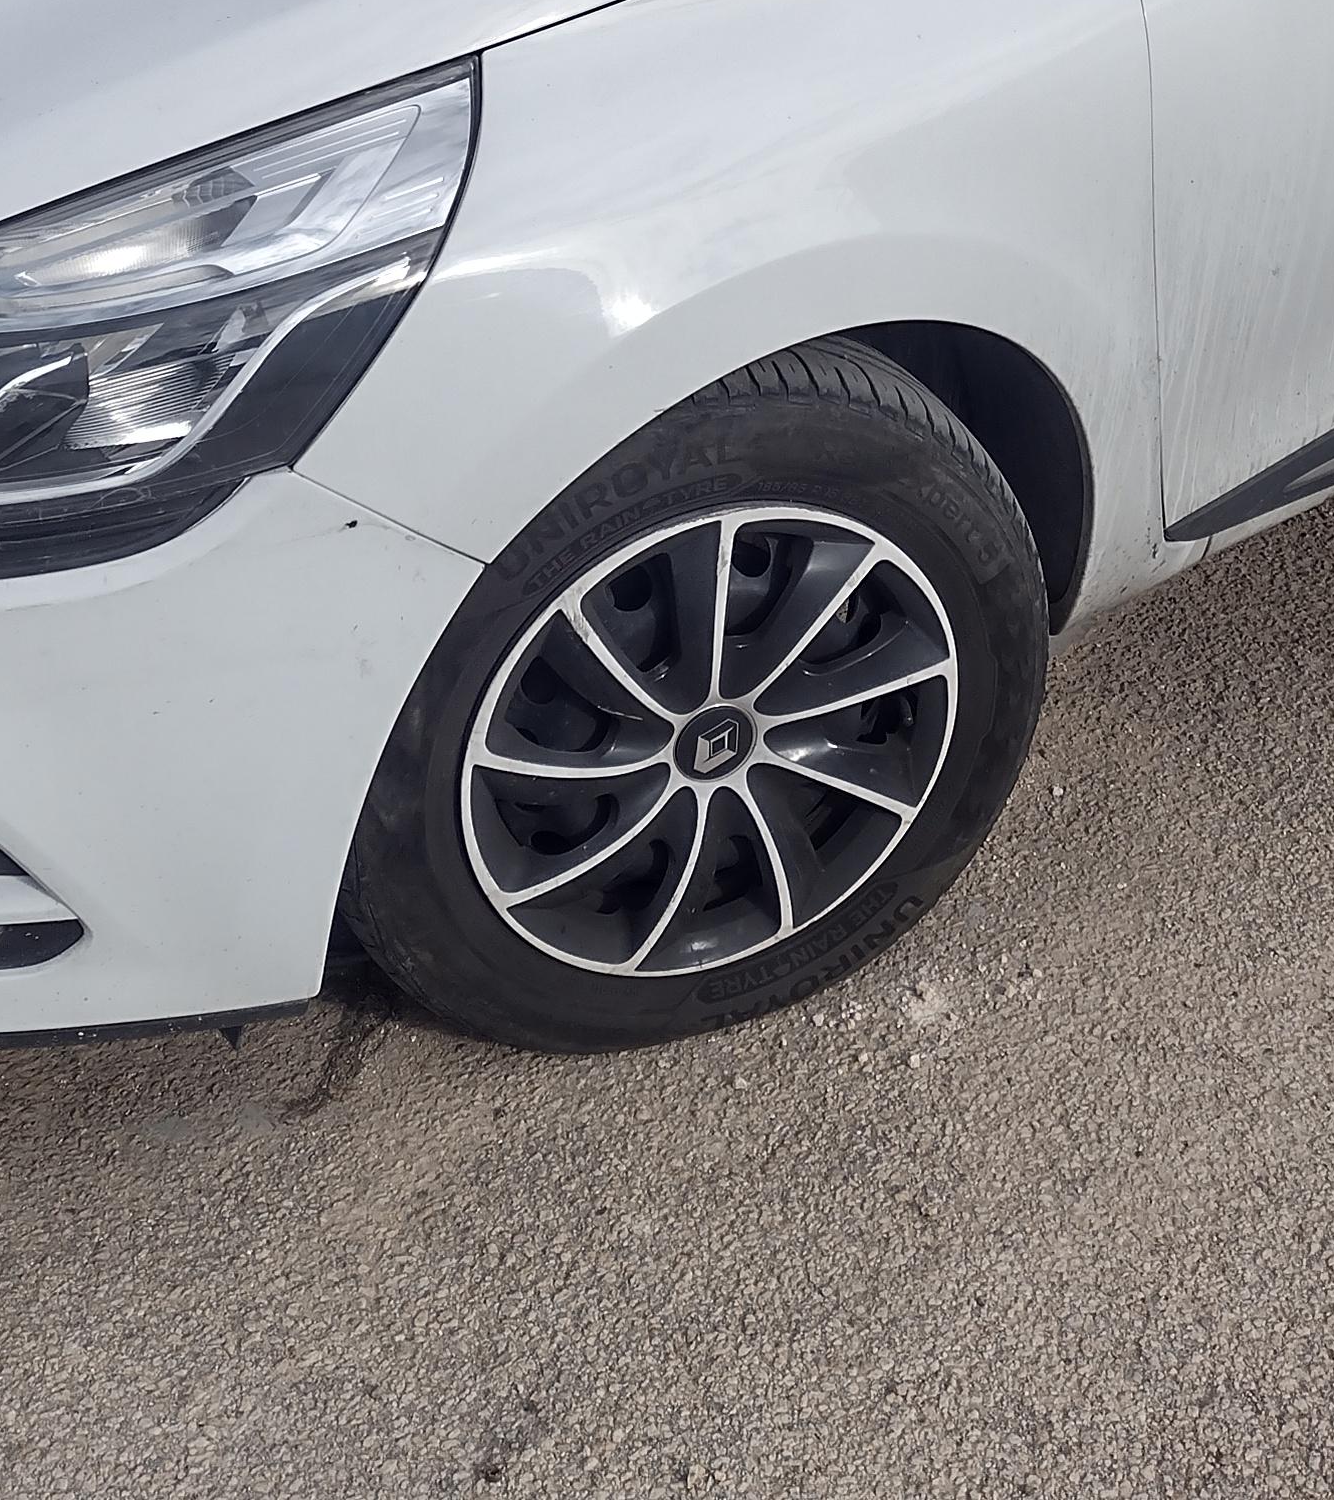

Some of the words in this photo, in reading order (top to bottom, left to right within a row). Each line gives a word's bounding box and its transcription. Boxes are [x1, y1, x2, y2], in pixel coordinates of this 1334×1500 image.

[494, 430, 743, 581] UNIROYAL
[529, 550, 579, 588] THE
[580, 506, 642, 549] RAIN
[667, 475, 729, 505] TYRE
